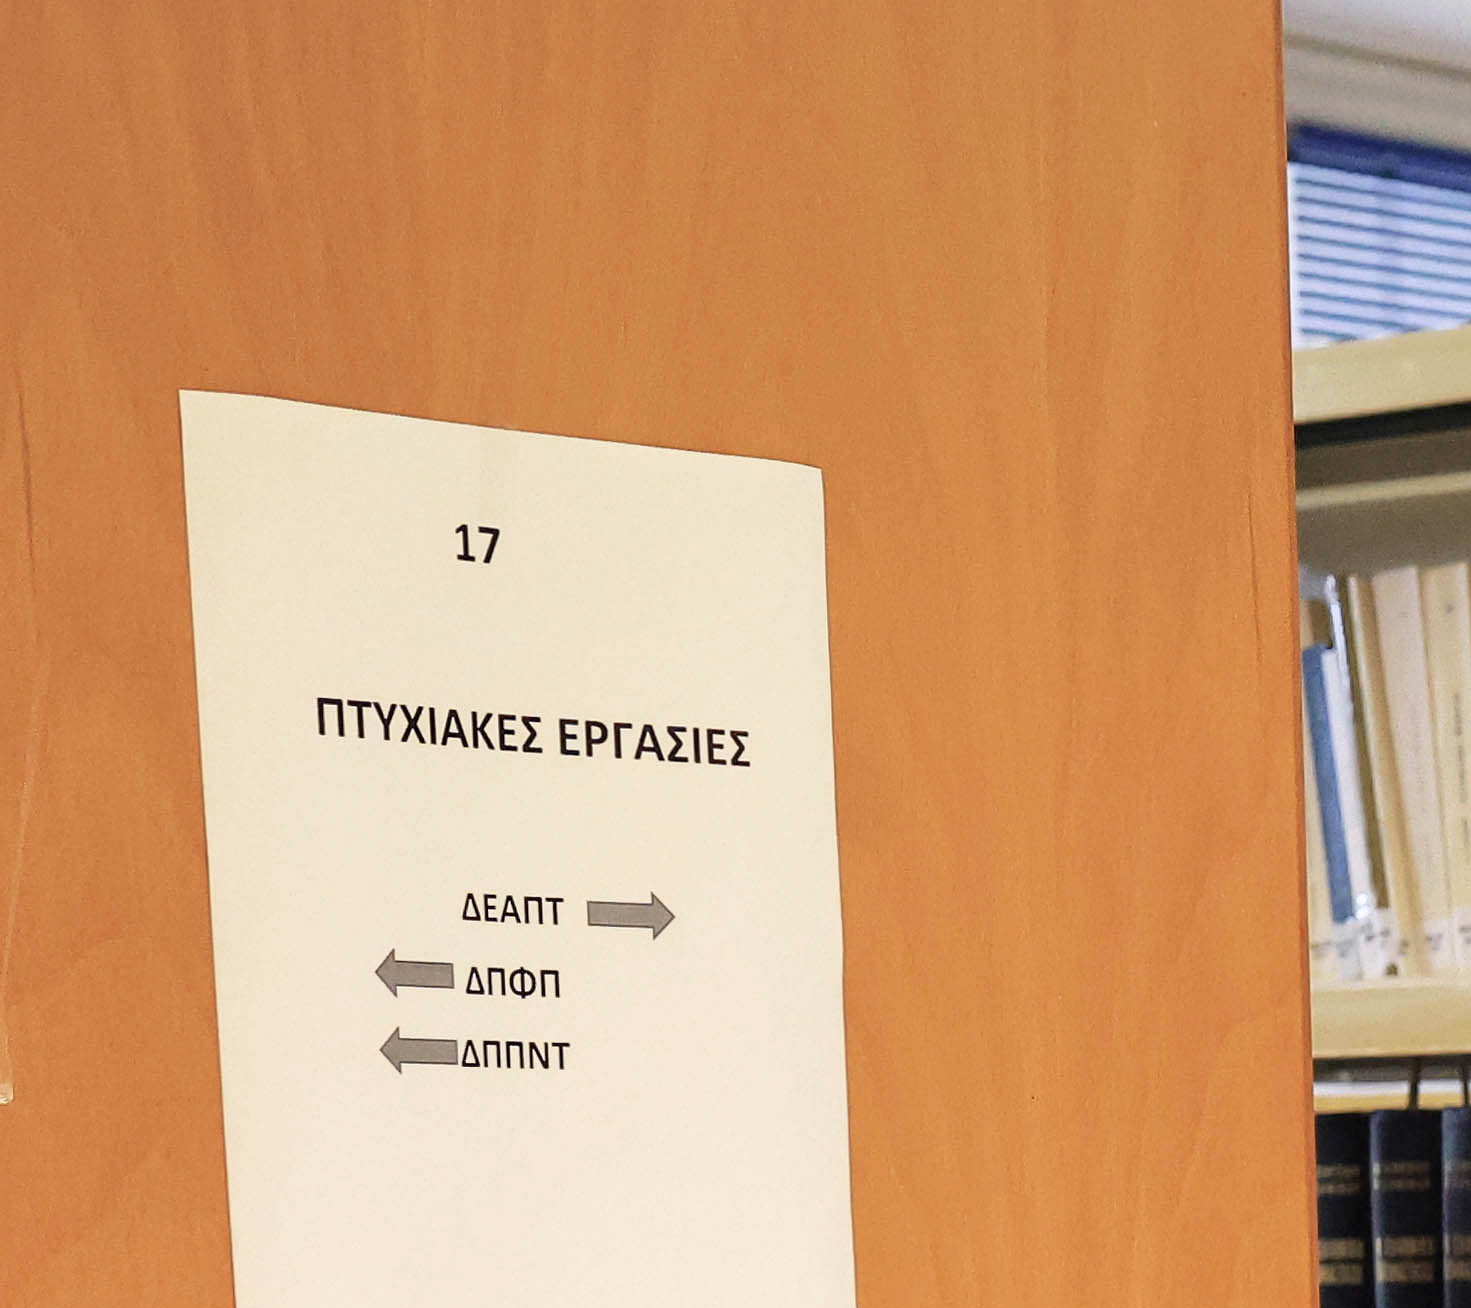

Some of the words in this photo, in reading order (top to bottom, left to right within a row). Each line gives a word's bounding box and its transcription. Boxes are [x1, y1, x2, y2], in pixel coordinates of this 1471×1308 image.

[455, 523, 500, 564] 17
[316, 696, 543, 754] ΠΤΥΧΙΑΚΕΣ
[558, 718, 752, 767] ΕΡΓΑΣΙΕΣ
[461, 893, 564, 925] ΔΕΑΠΤ
[466, 966, 560, 999] ΔΠΦΠ
[461, 1039, 570, 1069] ΔΠΠΝΤ
